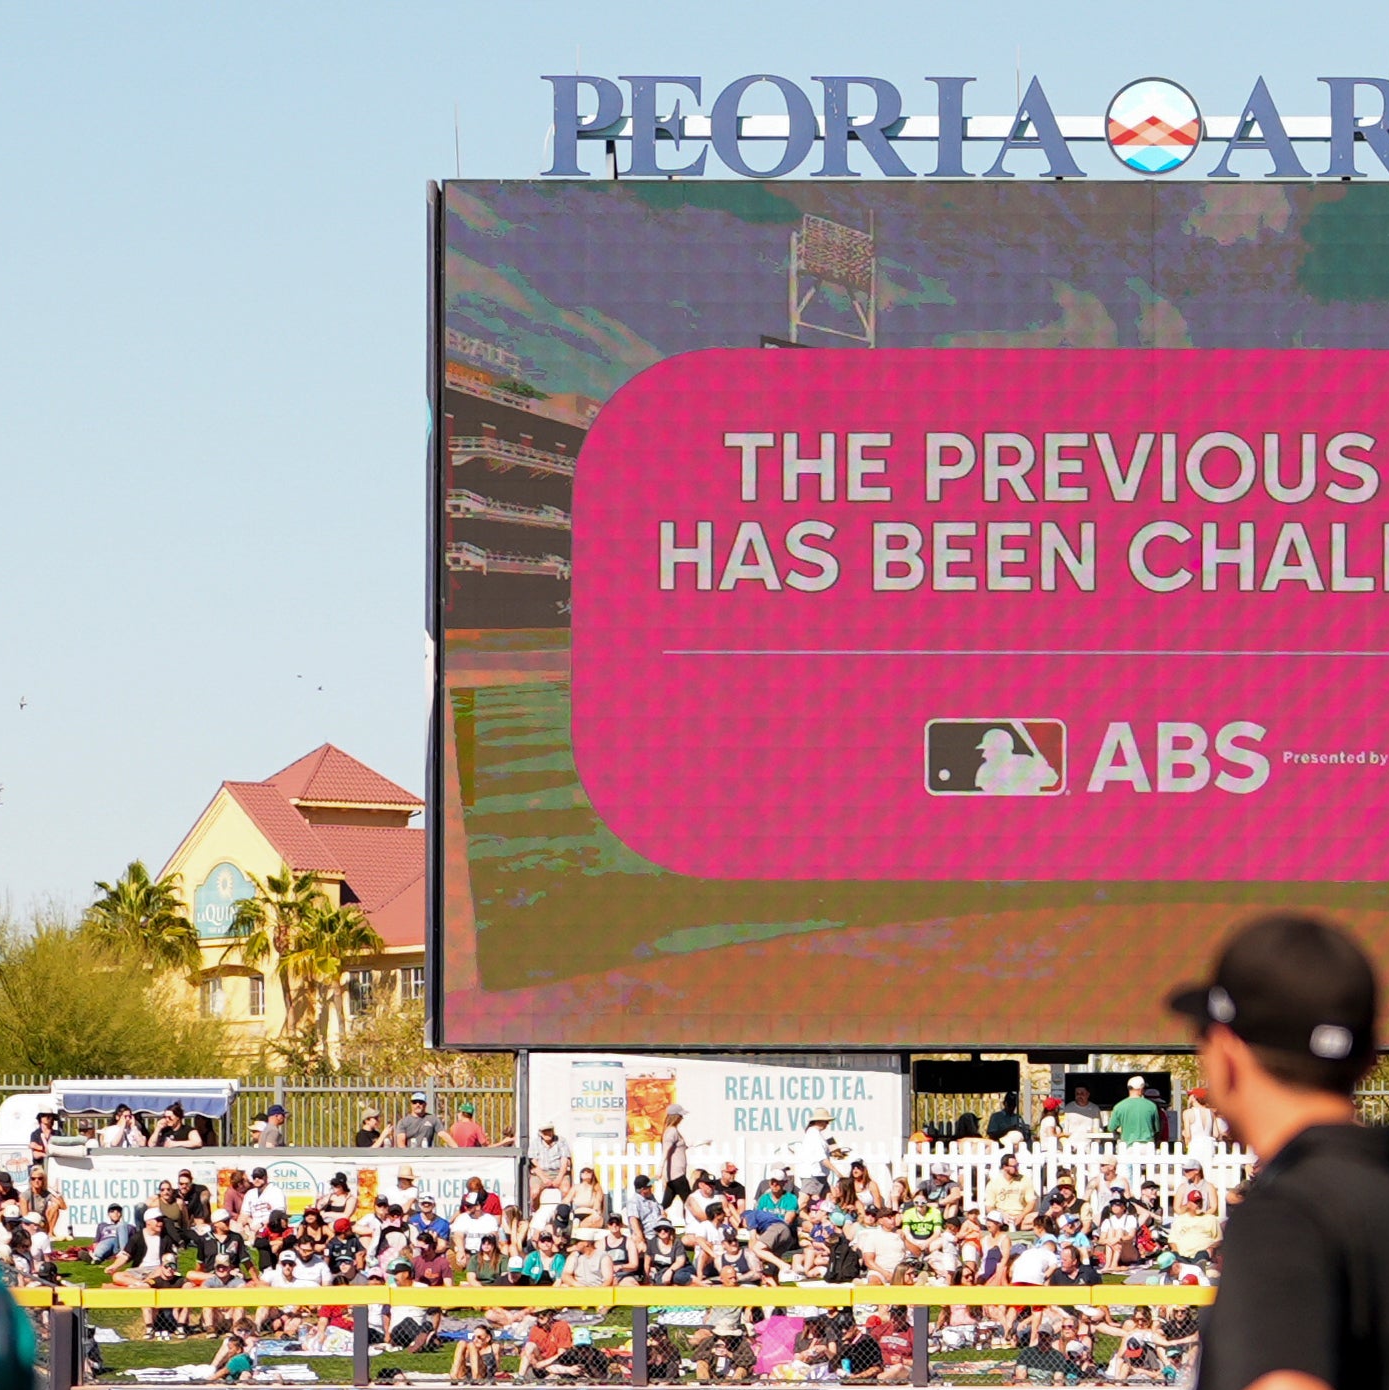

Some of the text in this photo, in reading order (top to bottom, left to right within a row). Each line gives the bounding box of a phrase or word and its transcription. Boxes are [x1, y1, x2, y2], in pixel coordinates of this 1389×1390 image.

[540, 74, 1087, 178] PEORIA
[723, 431, 893, 502] THE
[924, 430, 1380, 504] PREVIOUS
[658, 519, 840, 593] HAS
[871, 520, 1097, 592] BEEN
[1086, 720, 1271, 795] ABS
[1282, 751, 1366, 764] Presented
[1369, 751, 1389, 767] by
[582, 1081, 614, 1092] SUN
[725, 1076, 873, 1100] REAL ICED TEA.
[571, 1097, 624, 1108] CRUISER
[734, 1107, 864, 1132] REAL VOKA.
[273, 1169, 298, 1177] SUN
[62, 1179, 100, 1199] REAL
[104, 1179, 140, 1199] ICED
